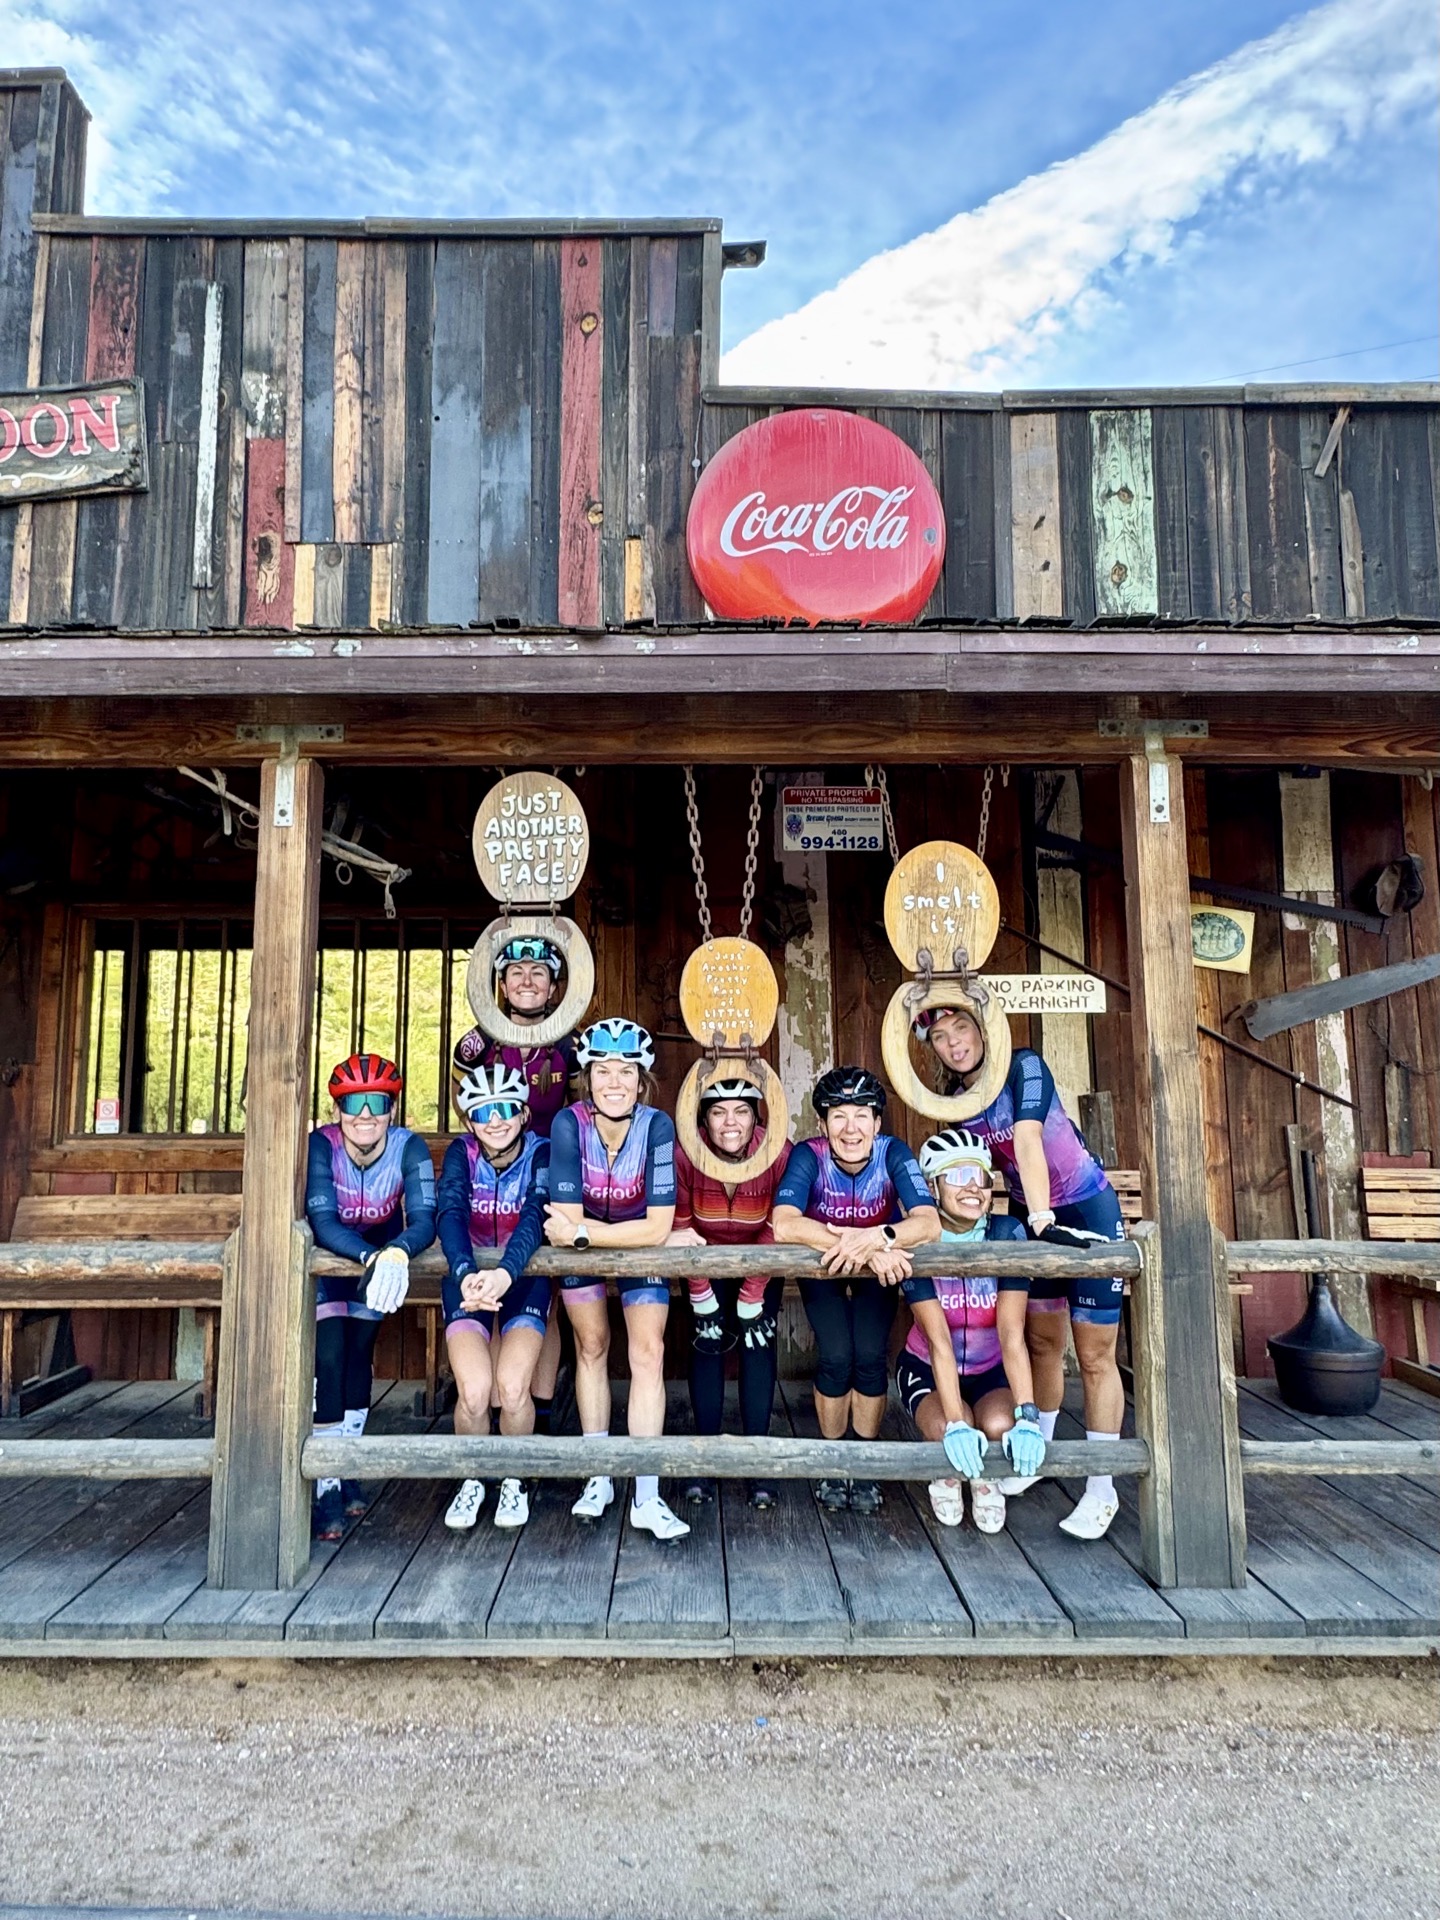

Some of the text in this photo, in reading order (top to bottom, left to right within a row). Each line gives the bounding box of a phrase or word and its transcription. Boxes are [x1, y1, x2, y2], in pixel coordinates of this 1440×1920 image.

[720, 485, 916, 557] Coca-Cola
[790, 789, 874, 797] PRIVATE PROPERTY
[501, 791, 562, 817] JUST
[484, 815, 583, 839] ANOTHER
[484, 837, 584, 864] PRETTY
[800, 836, 879, 849] 994-1128
[500, 860, 579, 886] FACE!
[936, 861, 945, 883] I
[903, 886, 981, 911] smelt
[930, 914, 964, 934] it.
[715, 951, 743, 961] Just
[988, 979, 1095, 993] NO PARKING
[996, 995, 1090, 1009] OVERNIGHT
[704, 1008, 750, 1018] LITTLE
[701, 1020, 754, 1030] SQUIRTS
[531, 1071, 563, 1085] STE
[583, 1179, 645, 1200] EGROUP
[817, 1199, 887, 1219] REGROUP
[940, 1292, 998, 1309] EGROUP
